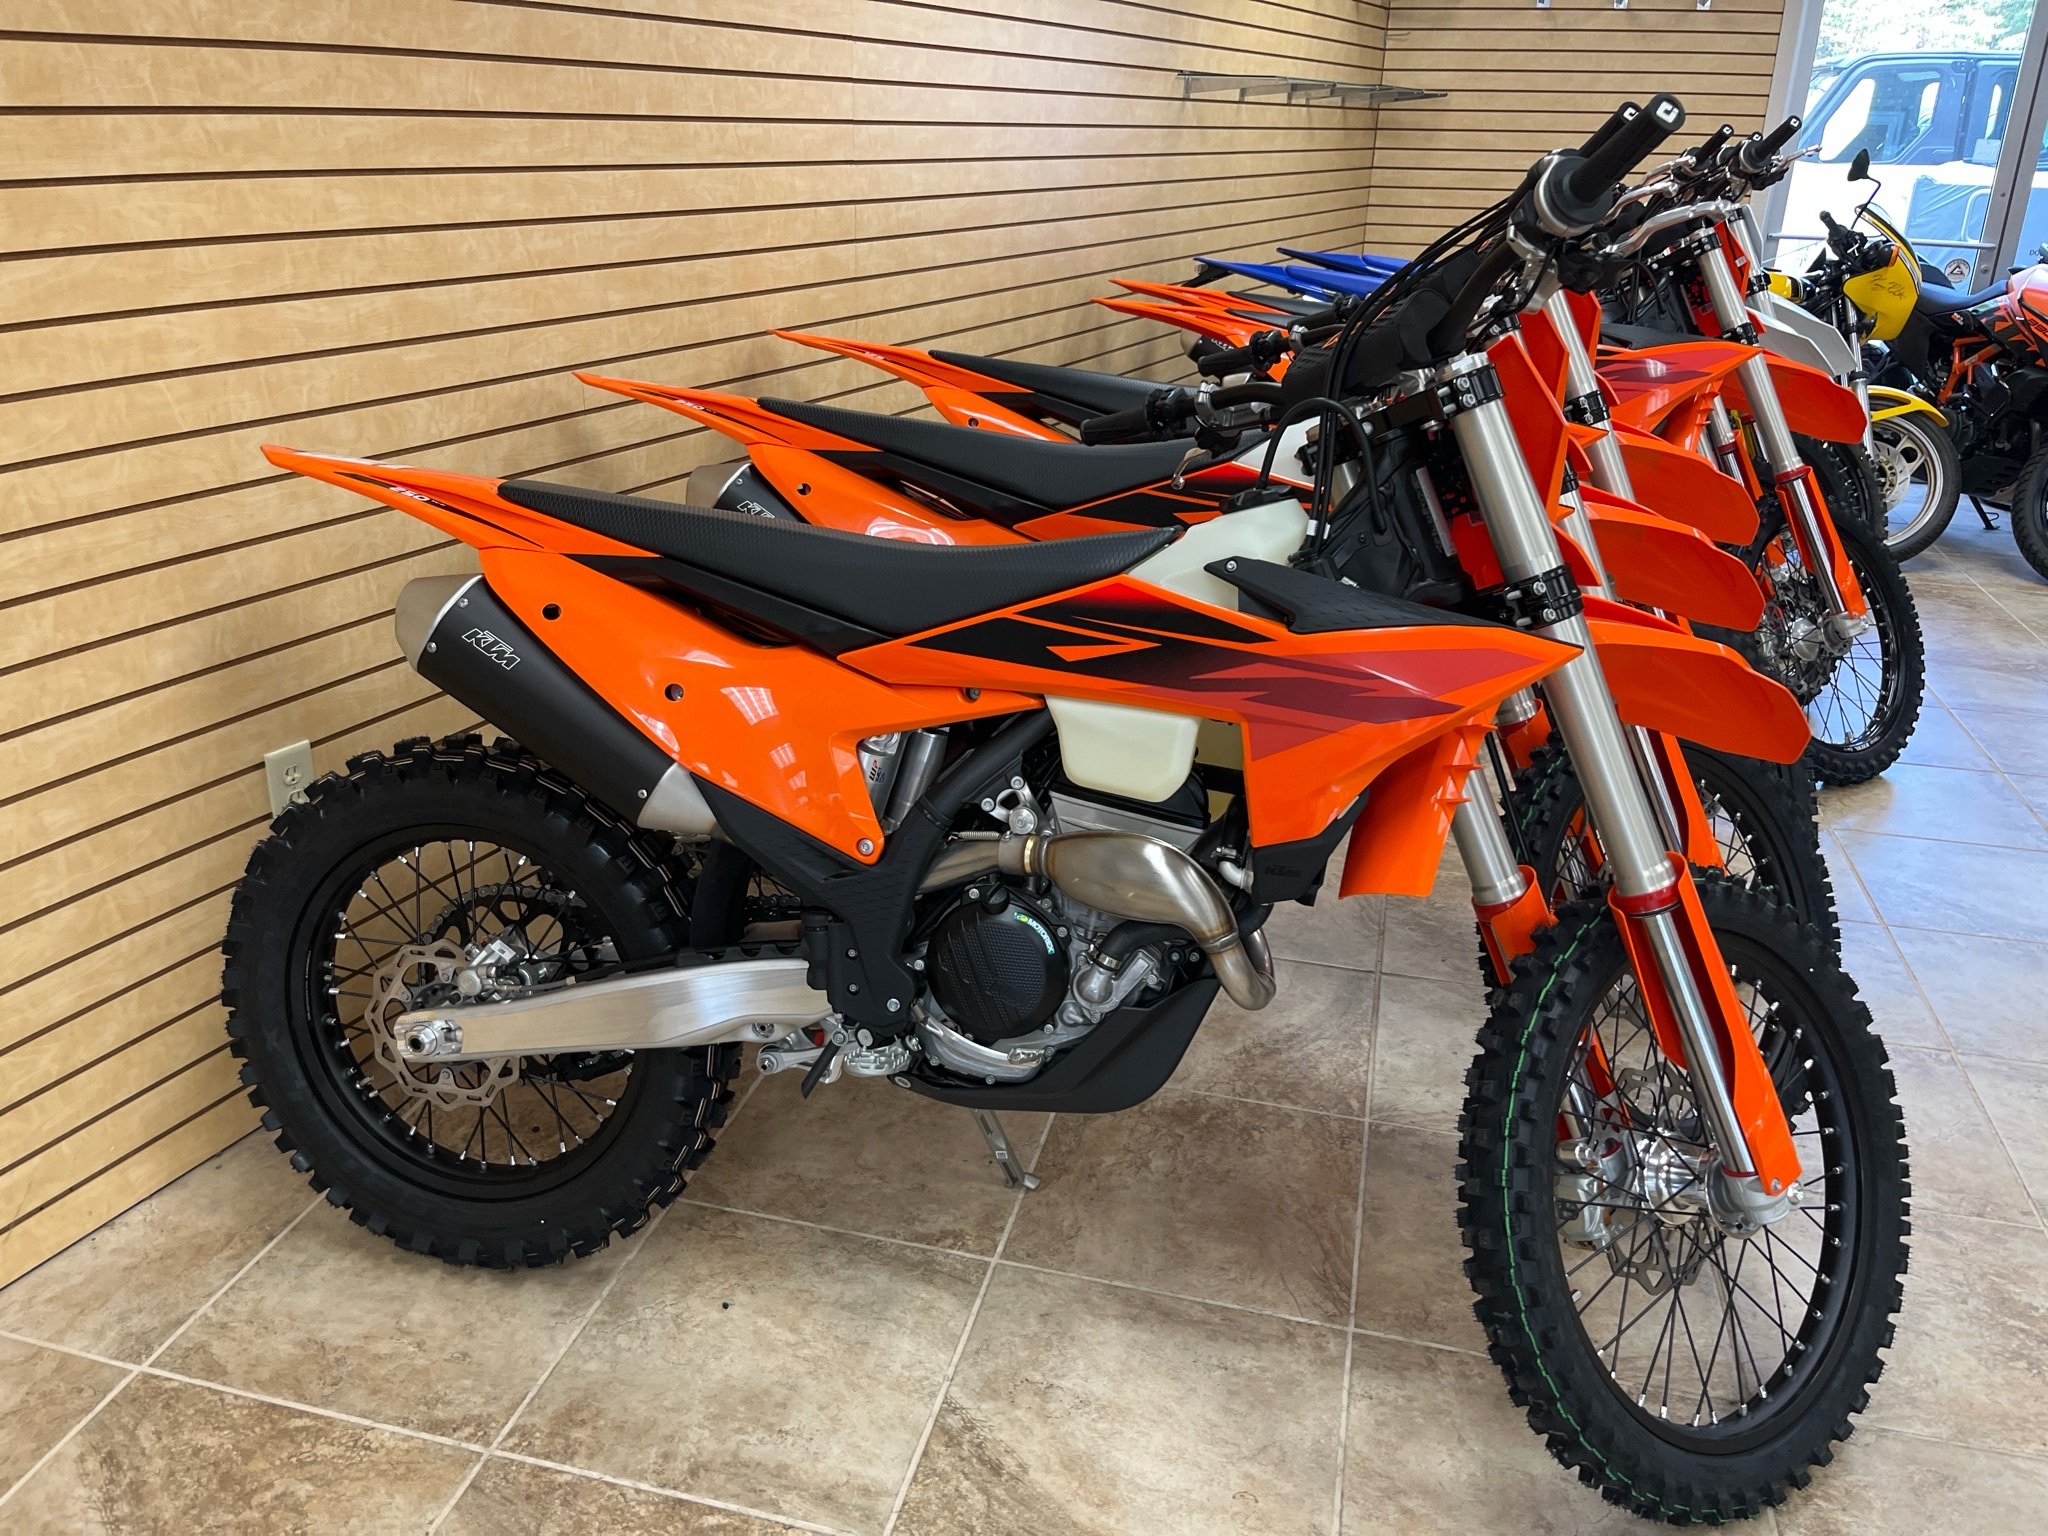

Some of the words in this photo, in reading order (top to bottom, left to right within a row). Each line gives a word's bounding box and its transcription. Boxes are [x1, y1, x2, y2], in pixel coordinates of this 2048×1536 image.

[389, 486, 430, 501] 250
[737, 500, 776, 519] KT
[461, 627, 521, 671] KTM
[1027, 917, 1056, 955] MOTOREX
